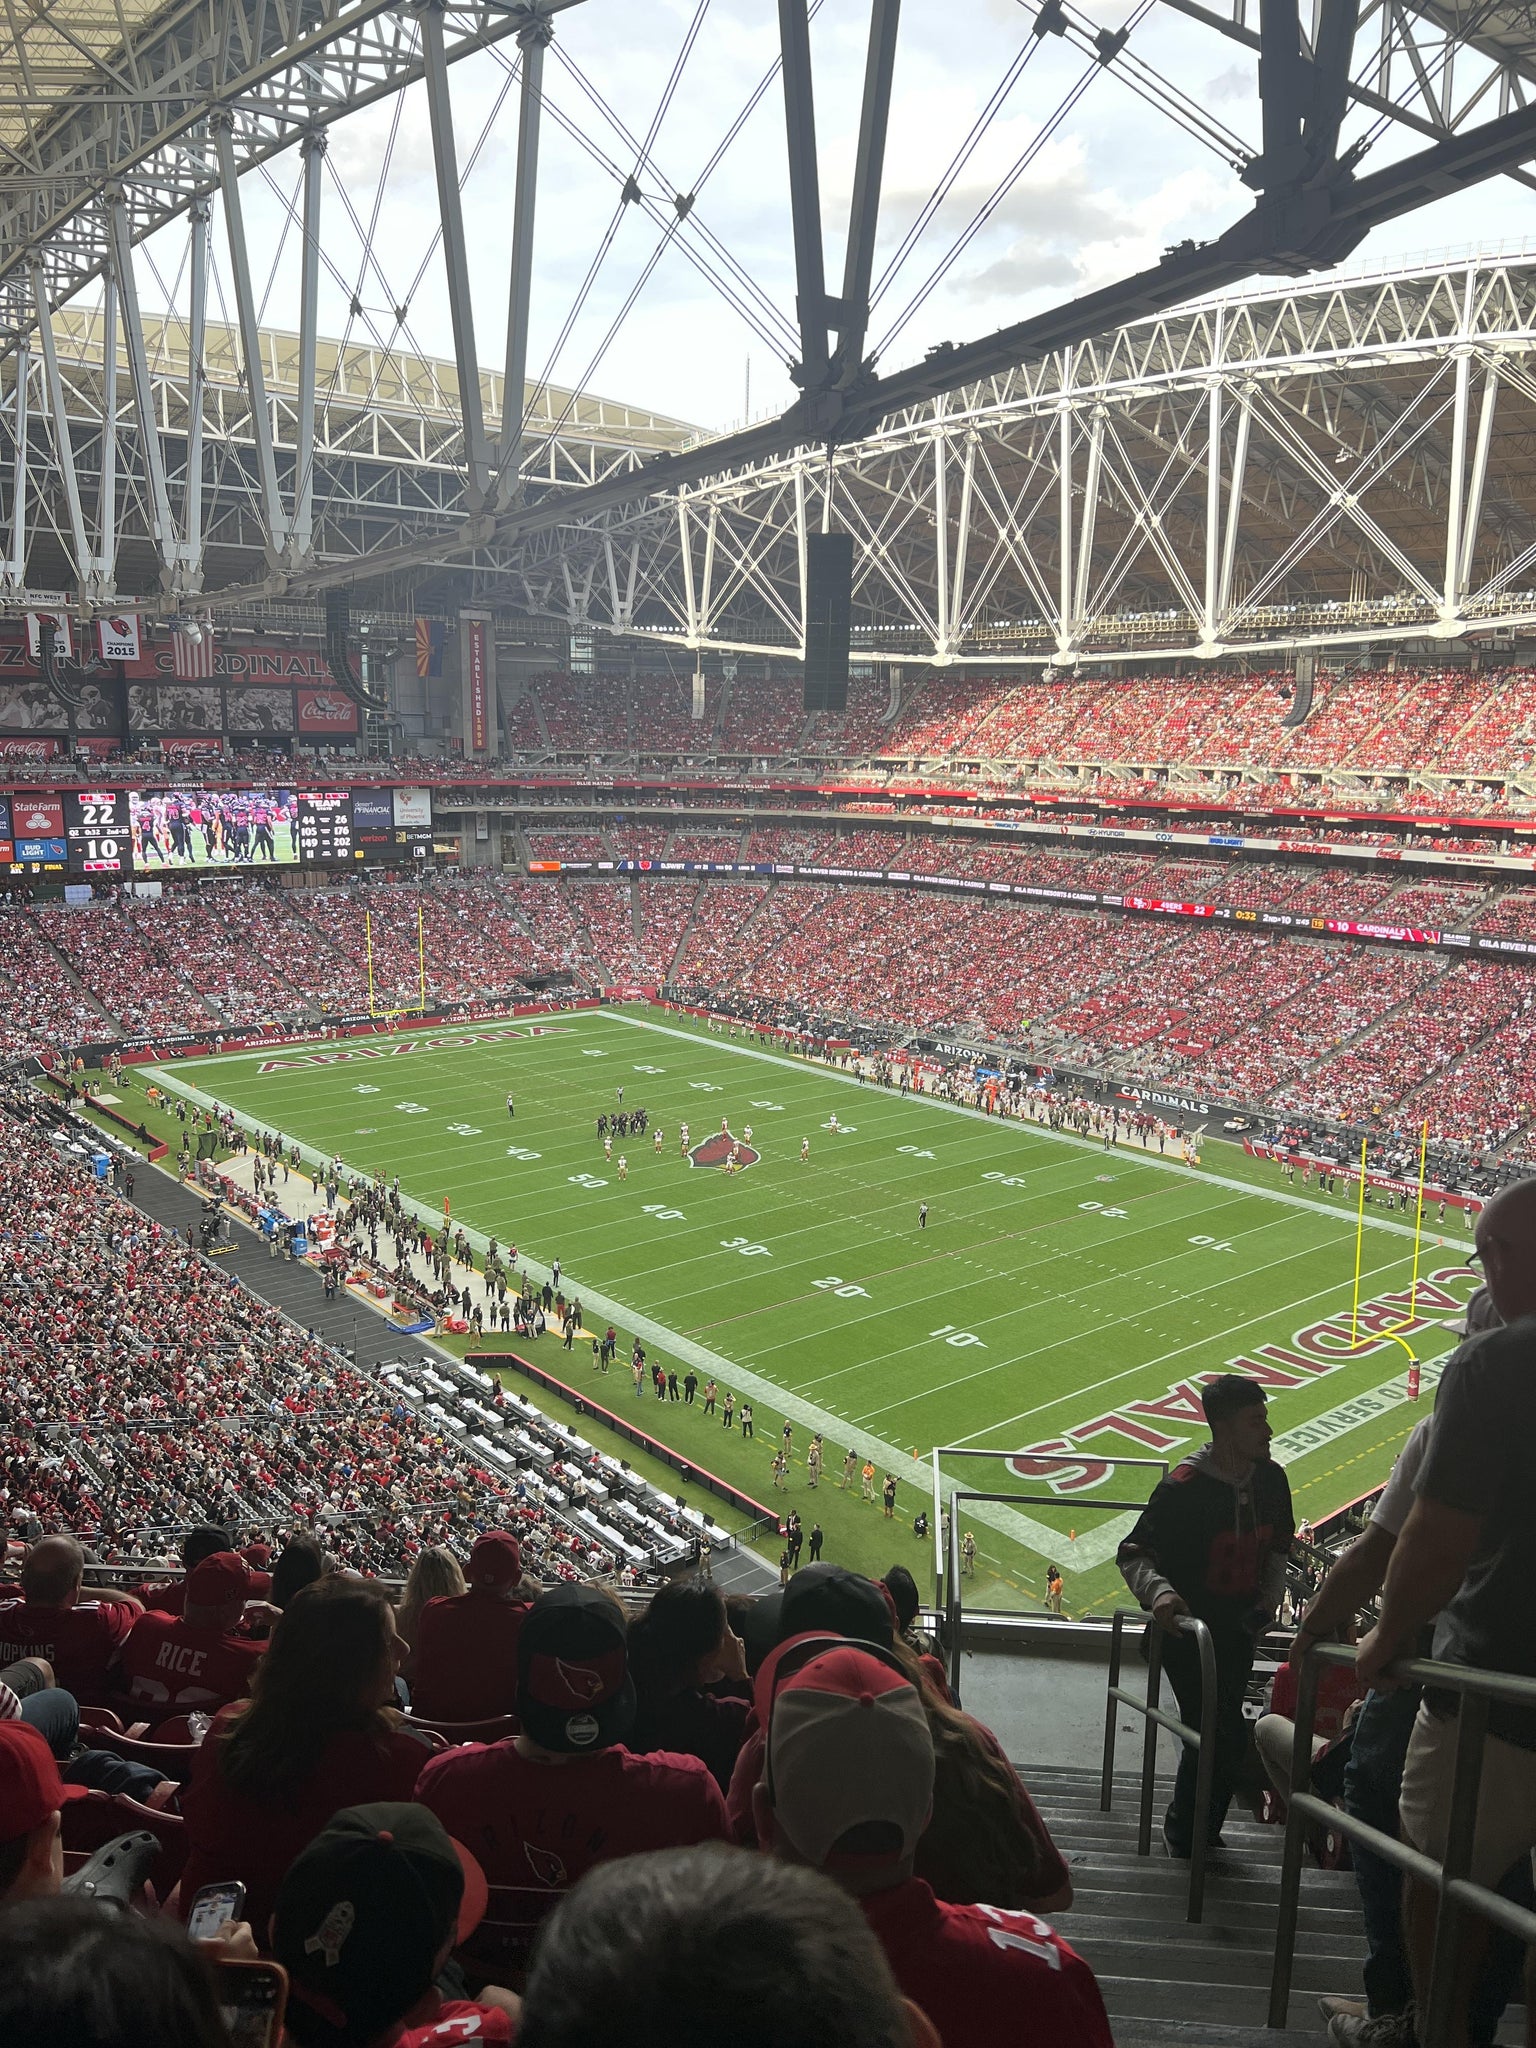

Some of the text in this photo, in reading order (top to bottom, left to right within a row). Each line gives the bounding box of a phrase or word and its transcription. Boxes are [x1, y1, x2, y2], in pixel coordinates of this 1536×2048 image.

[107, 646, 135, 656] 2015
[473, 634, 482, 716] ESTABLISHED
[307, 799, 341, 808] TEAM
[83, 804, 115, 825] 22
[302, 815, 316, 825] 44
[334, 814, 348, 824] 26
[69, 829, 80, 837] Q2
[301, 827, 318, 837] 105
[333, 826, 350, 835] 176
[360, 834, 388, 843] verizon
[1155, 832, 1173, 841] COX
[87, 838, 118, 859] 10
[301, 838, 318, 848] 149
[333, 837, 351, 847] 202
[337, 848, 348, 858] 10
[828, 869, 853, 877] RESORTS
[938, 877, 959, 885] RESORTS
[964, 880, 985, 889] CASINOS
[1043, 889, 1067, 898] RESORTS
[1072, 893, 1097, 901] CASINOS
[1161, 901, 1182, 910] 49ERS
[1194, 906, 1206, 915] 22
[1223, 909, 1230, 917] 2
[1236, 910, 1257, 921] 0:32
[1337, 921, 1406, 937] 10 CARDINALS
[1479, 939, 1500, 949] GILA
[1500, 941, 1526, 952] RIVER
[341, 1014, 370, 1022] ARIZONA
[156, 1034, 196, 1045] CARDINALS
[244, 1036, 282, 1047] ARIZONA
[256, 1025, 578, 1074] ARIZONA
[1121, 1086, 1209, 1114] CARDINALS
[394, 1101, 430, 1114] 20
[447, 1122, 484, 1136] 30
[507, 1146, 543, 1161] 40
[896, 1144, 935, 1159] 40
[567, 1173, 609, 1189] 50
[981, 1171, 1023, 1187] 30
[641, 1204, 683, 1220] 40
[1077, 1201, 1126, 1218] 20
[720, 1237, 768, 1256] 30
[1187, 1234, 1233, 1252] 10
[810, 1276, 865, 1298] 20
[928, 1324, 980, 1347] 10
[1277, 1397, 1385, 1454] SERVICE
[156, 1640, 208, 1677] RICE
